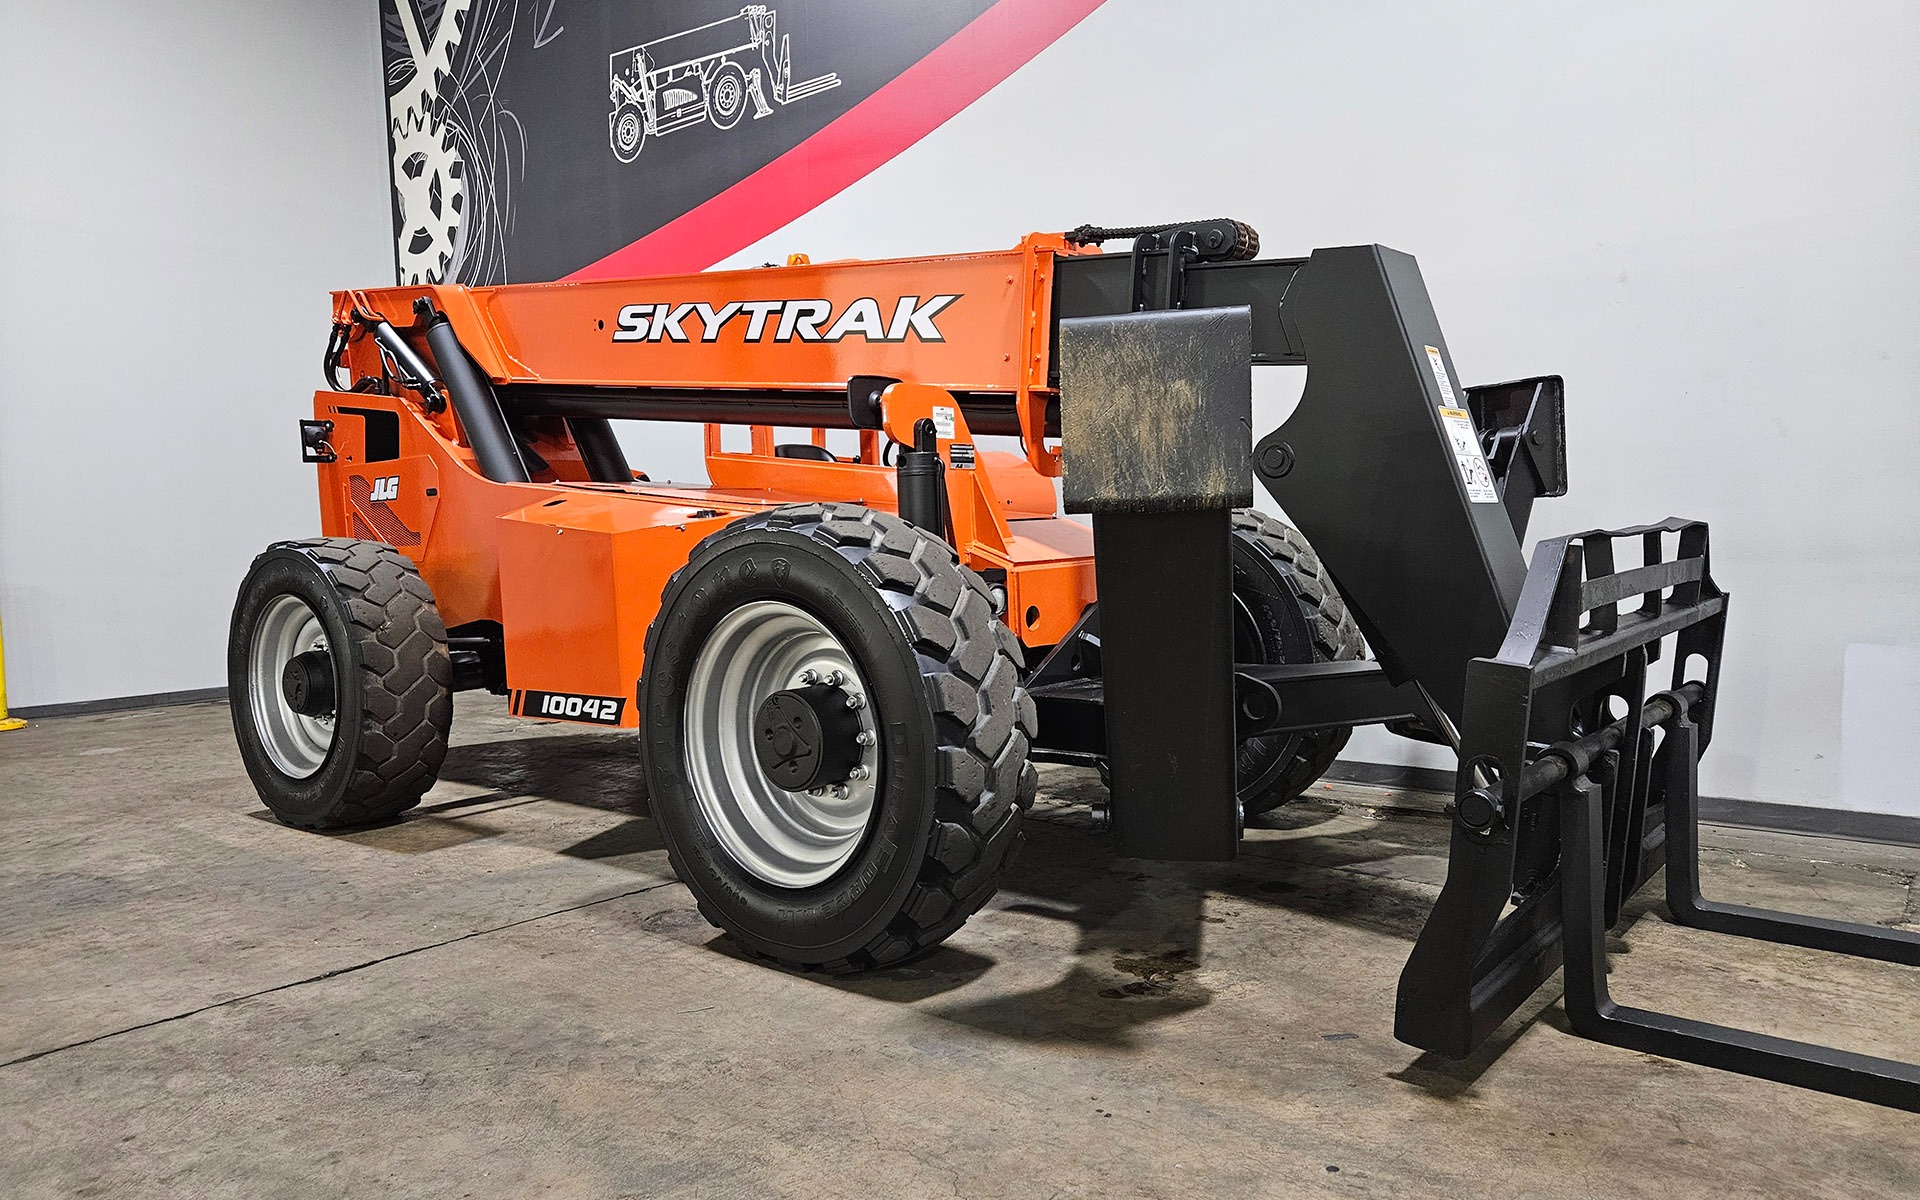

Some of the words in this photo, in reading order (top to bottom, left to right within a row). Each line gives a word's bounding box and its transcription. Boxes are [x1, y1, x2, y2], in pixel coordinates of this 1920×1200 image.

[612, 294, 964, 343] SKYTRAK
[369, 476, 400, 503] JLG
[541, 695, 618, 721] 10042
